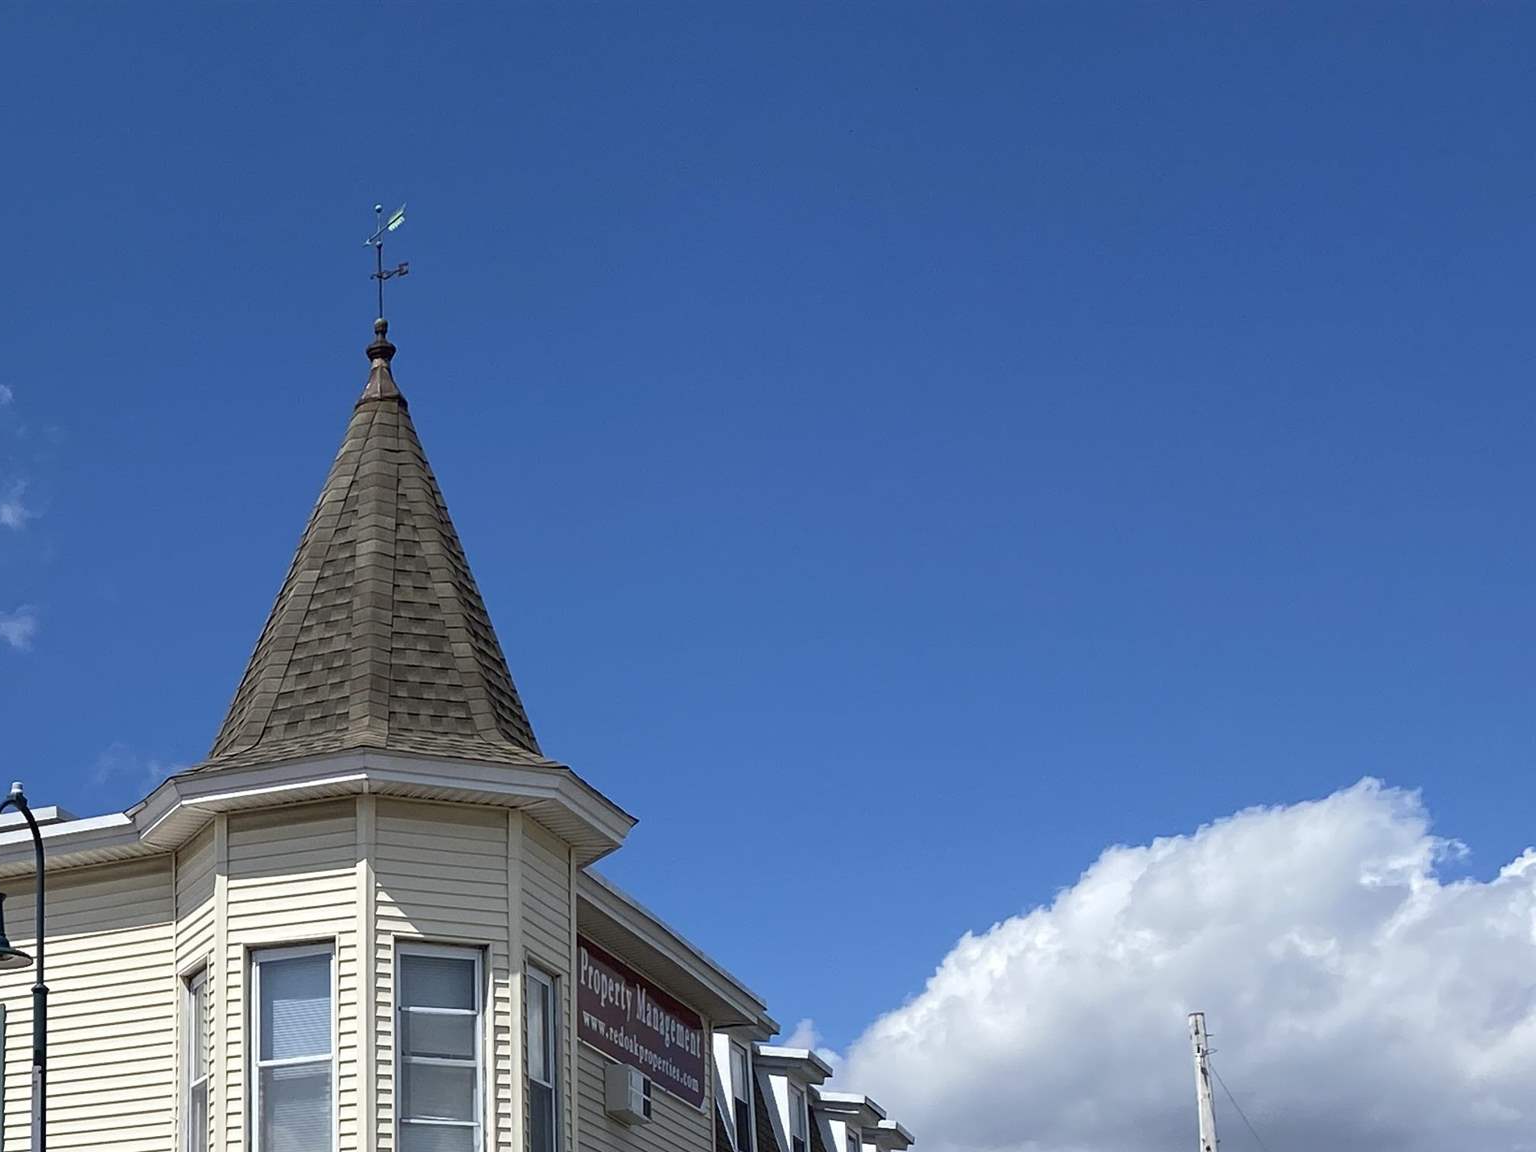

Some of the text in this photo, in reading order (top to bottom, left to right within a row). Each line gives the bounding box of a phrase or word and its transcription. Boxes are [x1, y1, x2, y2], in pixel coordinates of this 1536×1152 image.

[580, 946, 701, 1059] Property Management
[582, 1010, 700, 1093] www.redoakproperties.com
